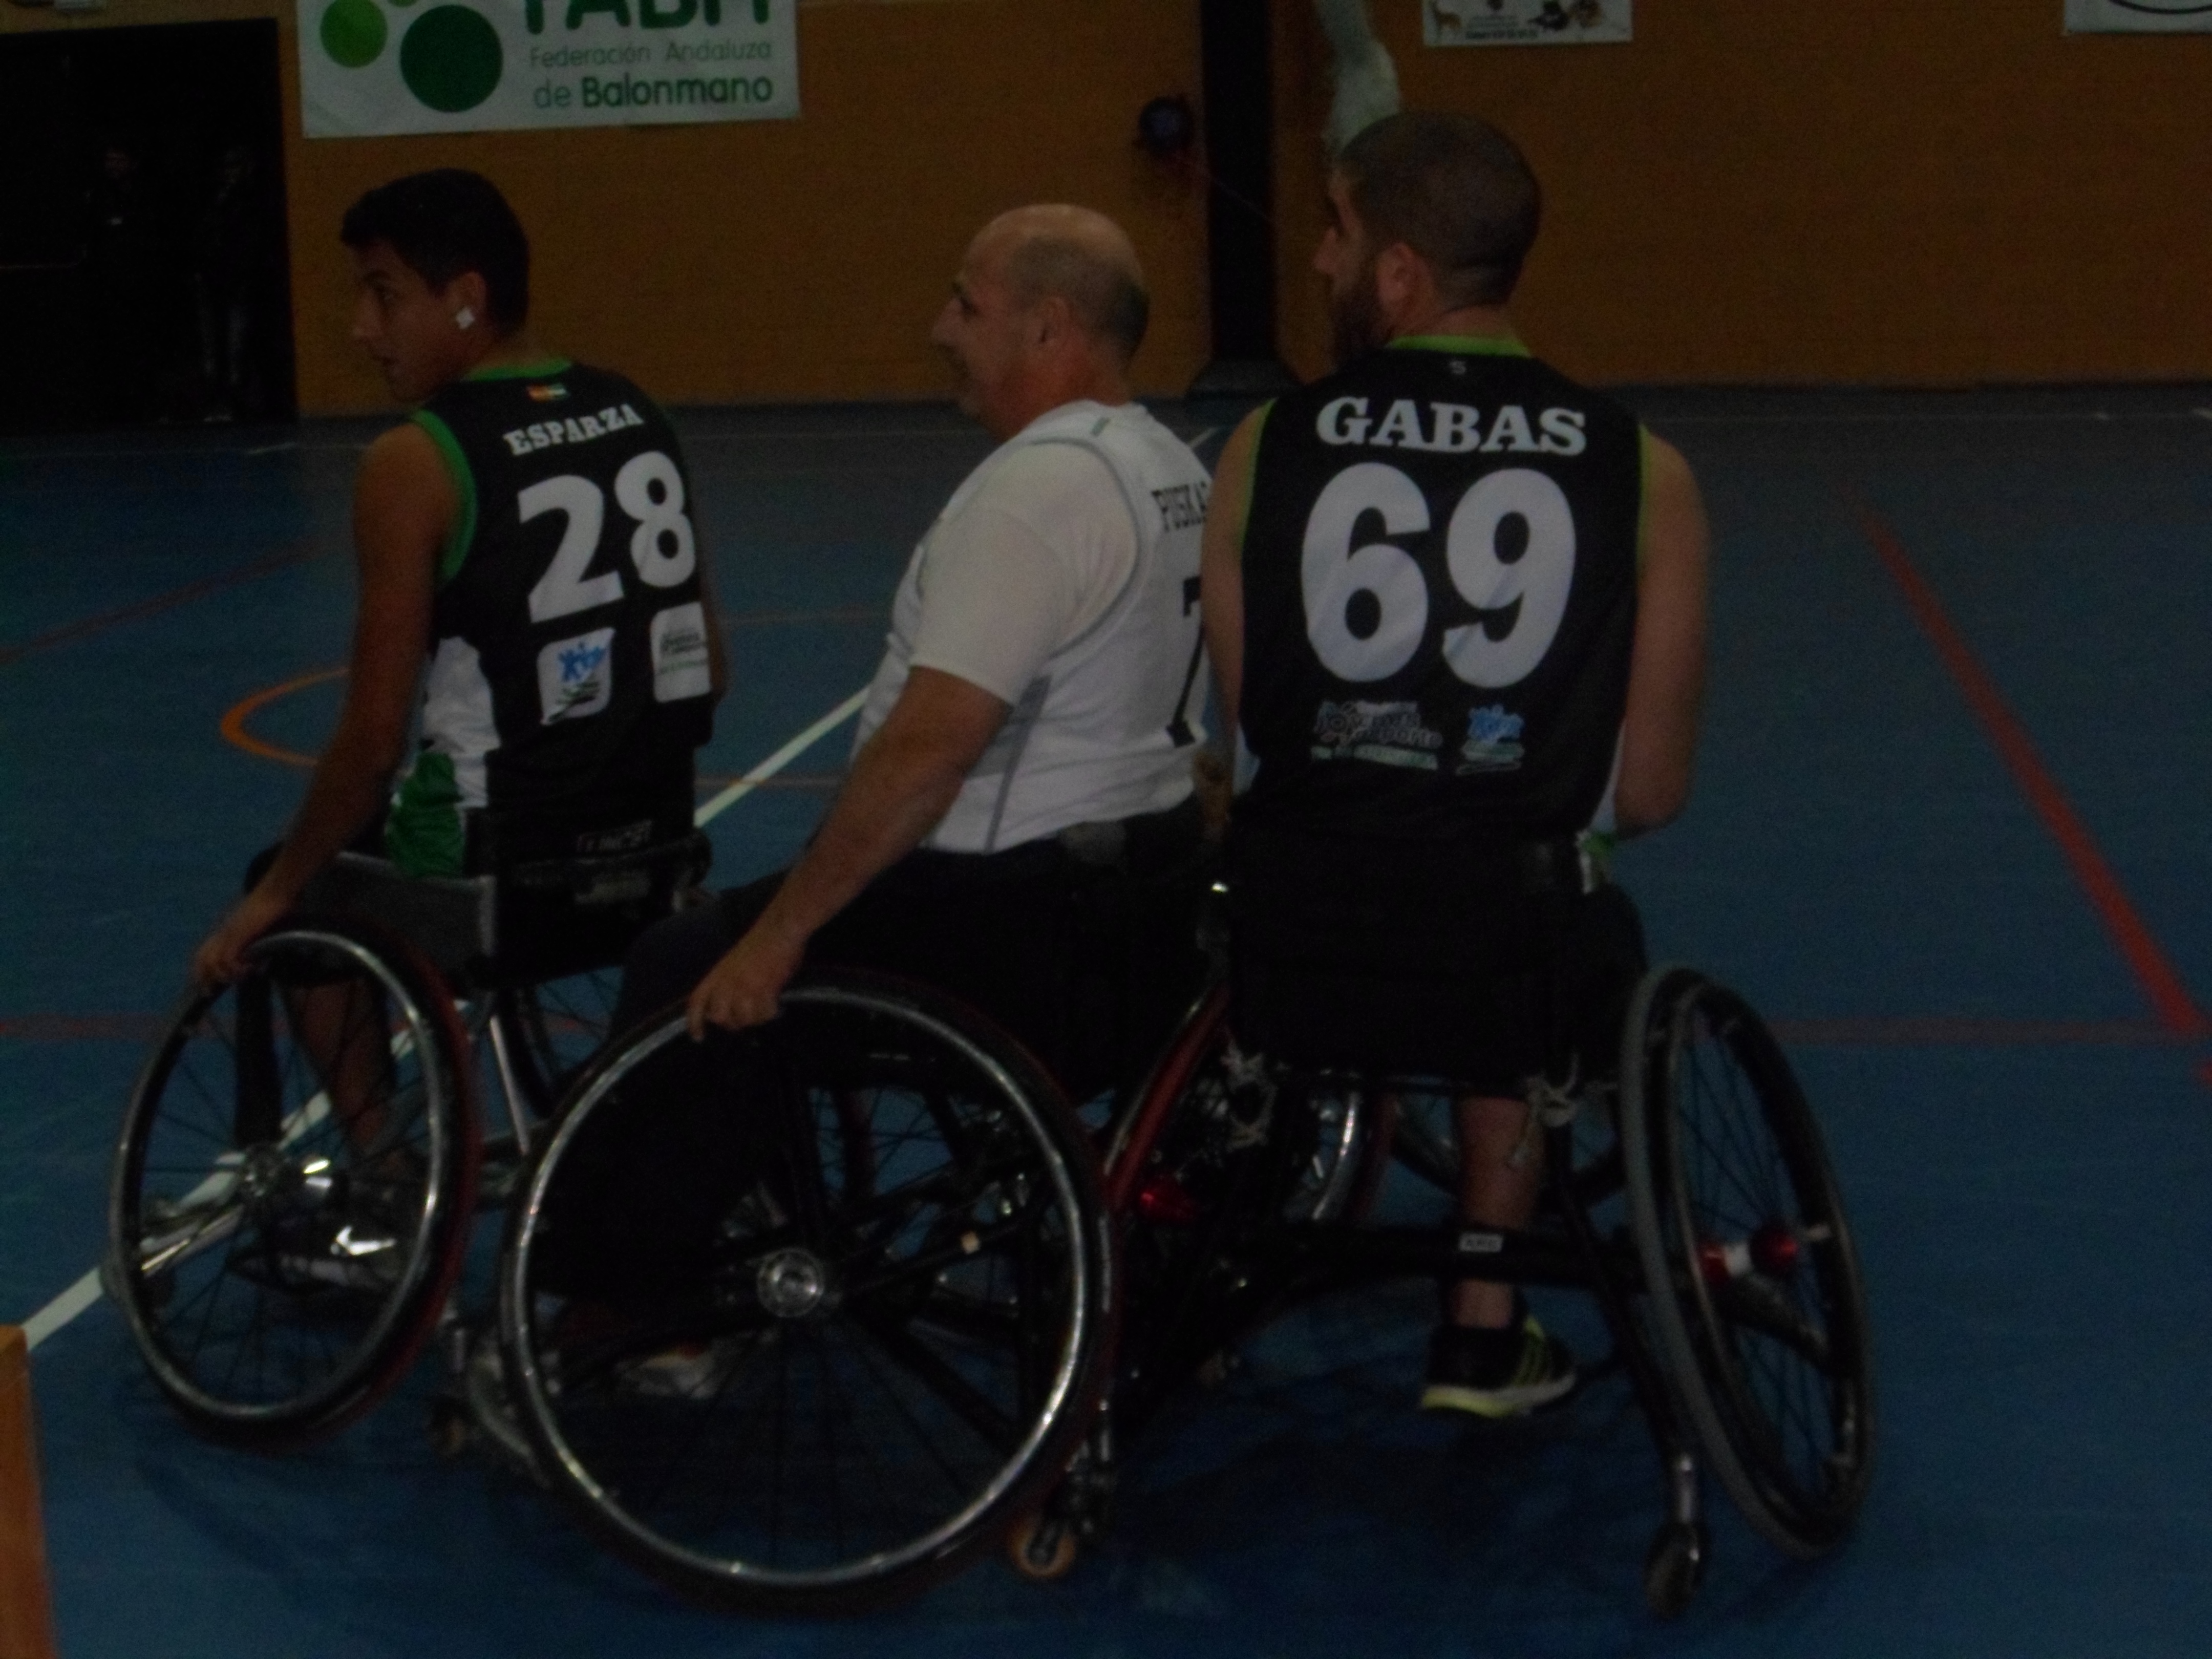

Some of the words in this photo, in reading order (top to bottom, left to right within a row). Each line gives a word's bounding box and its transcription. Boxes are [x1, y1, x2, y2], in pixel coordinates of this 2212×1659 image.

[666, 39, 772, 62] Andaluza
[534, 78, 571, 109] de
[582, 73, 773, 108] Balonmano
[502, 403, 645, 457] ESPARZA
[1315, 396, 1587, 457] GABAS
[517, 450, 696, 624] 28
[1301, 461, 1577, 689] 69
